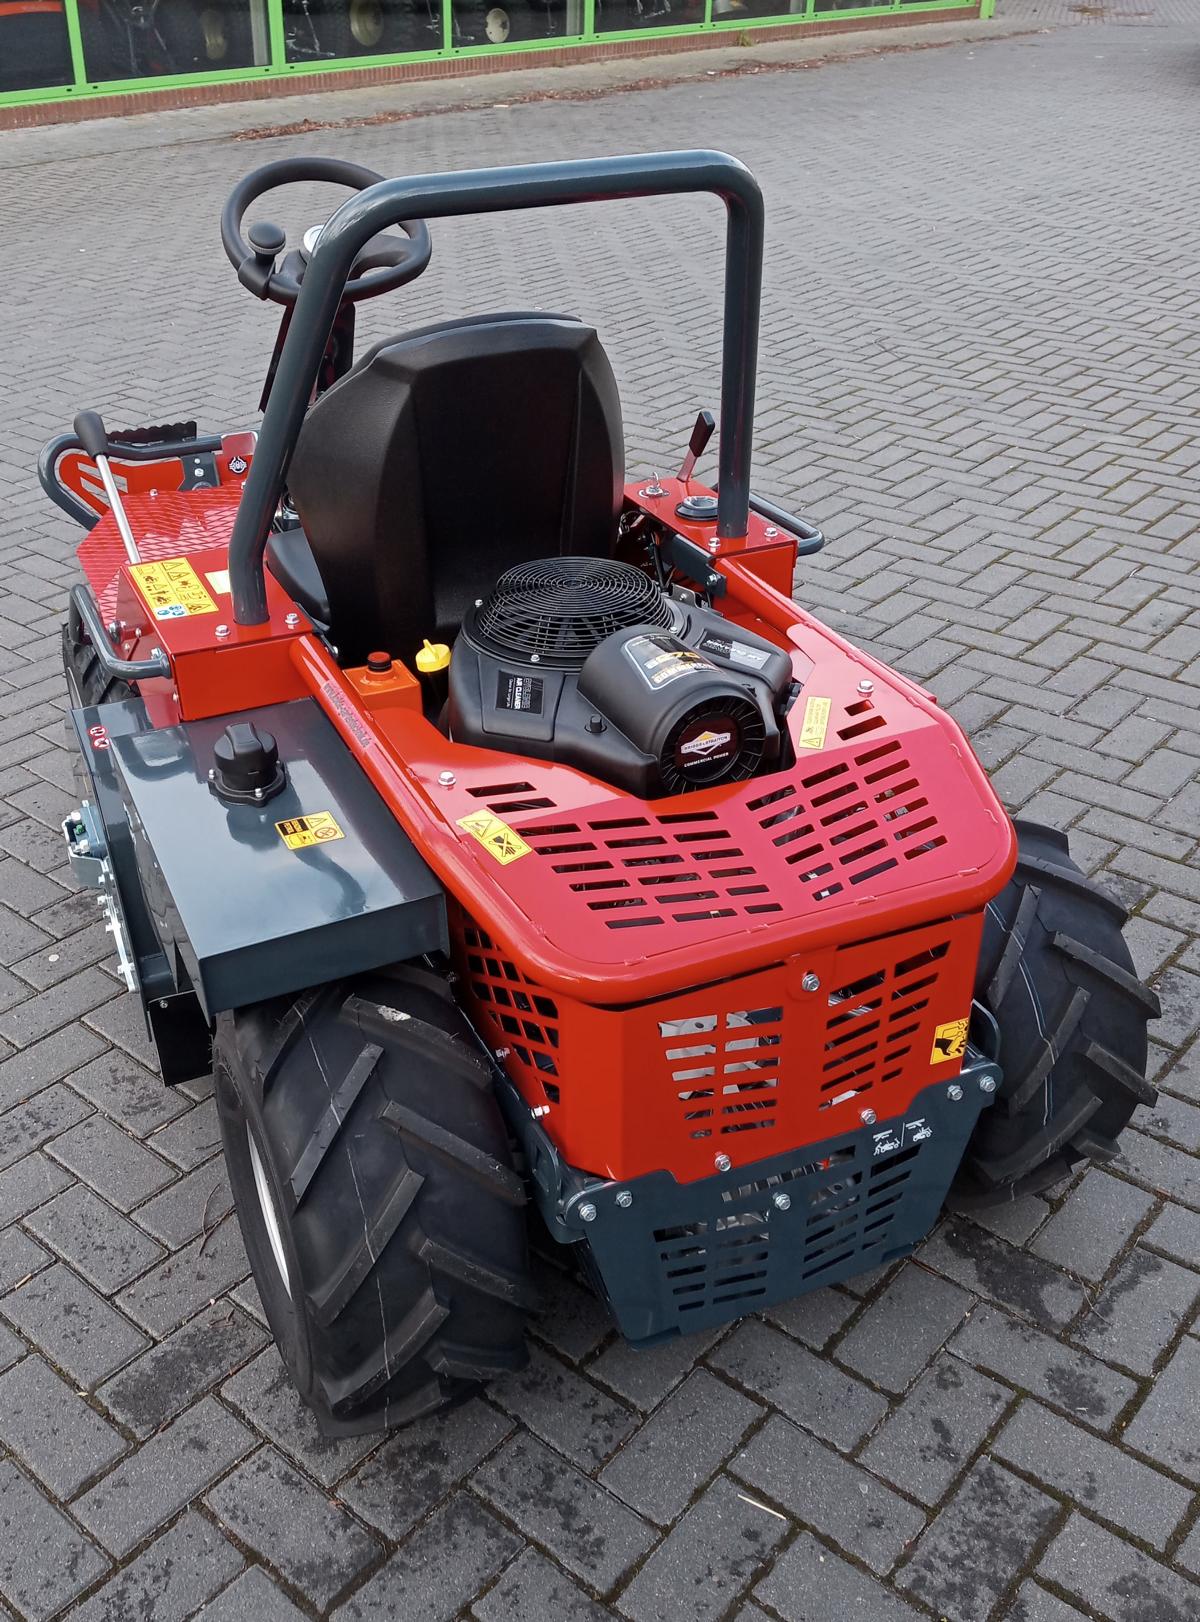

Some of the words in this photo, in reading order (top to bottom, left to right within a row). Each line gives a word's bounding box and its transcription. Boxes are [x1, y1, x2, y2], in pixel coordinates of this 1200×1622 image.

[514, 686, 523, 709] CLEANER
[684, 757, 713, 767] COMMERCIAL
[713, 752, 729, 760] POWER
